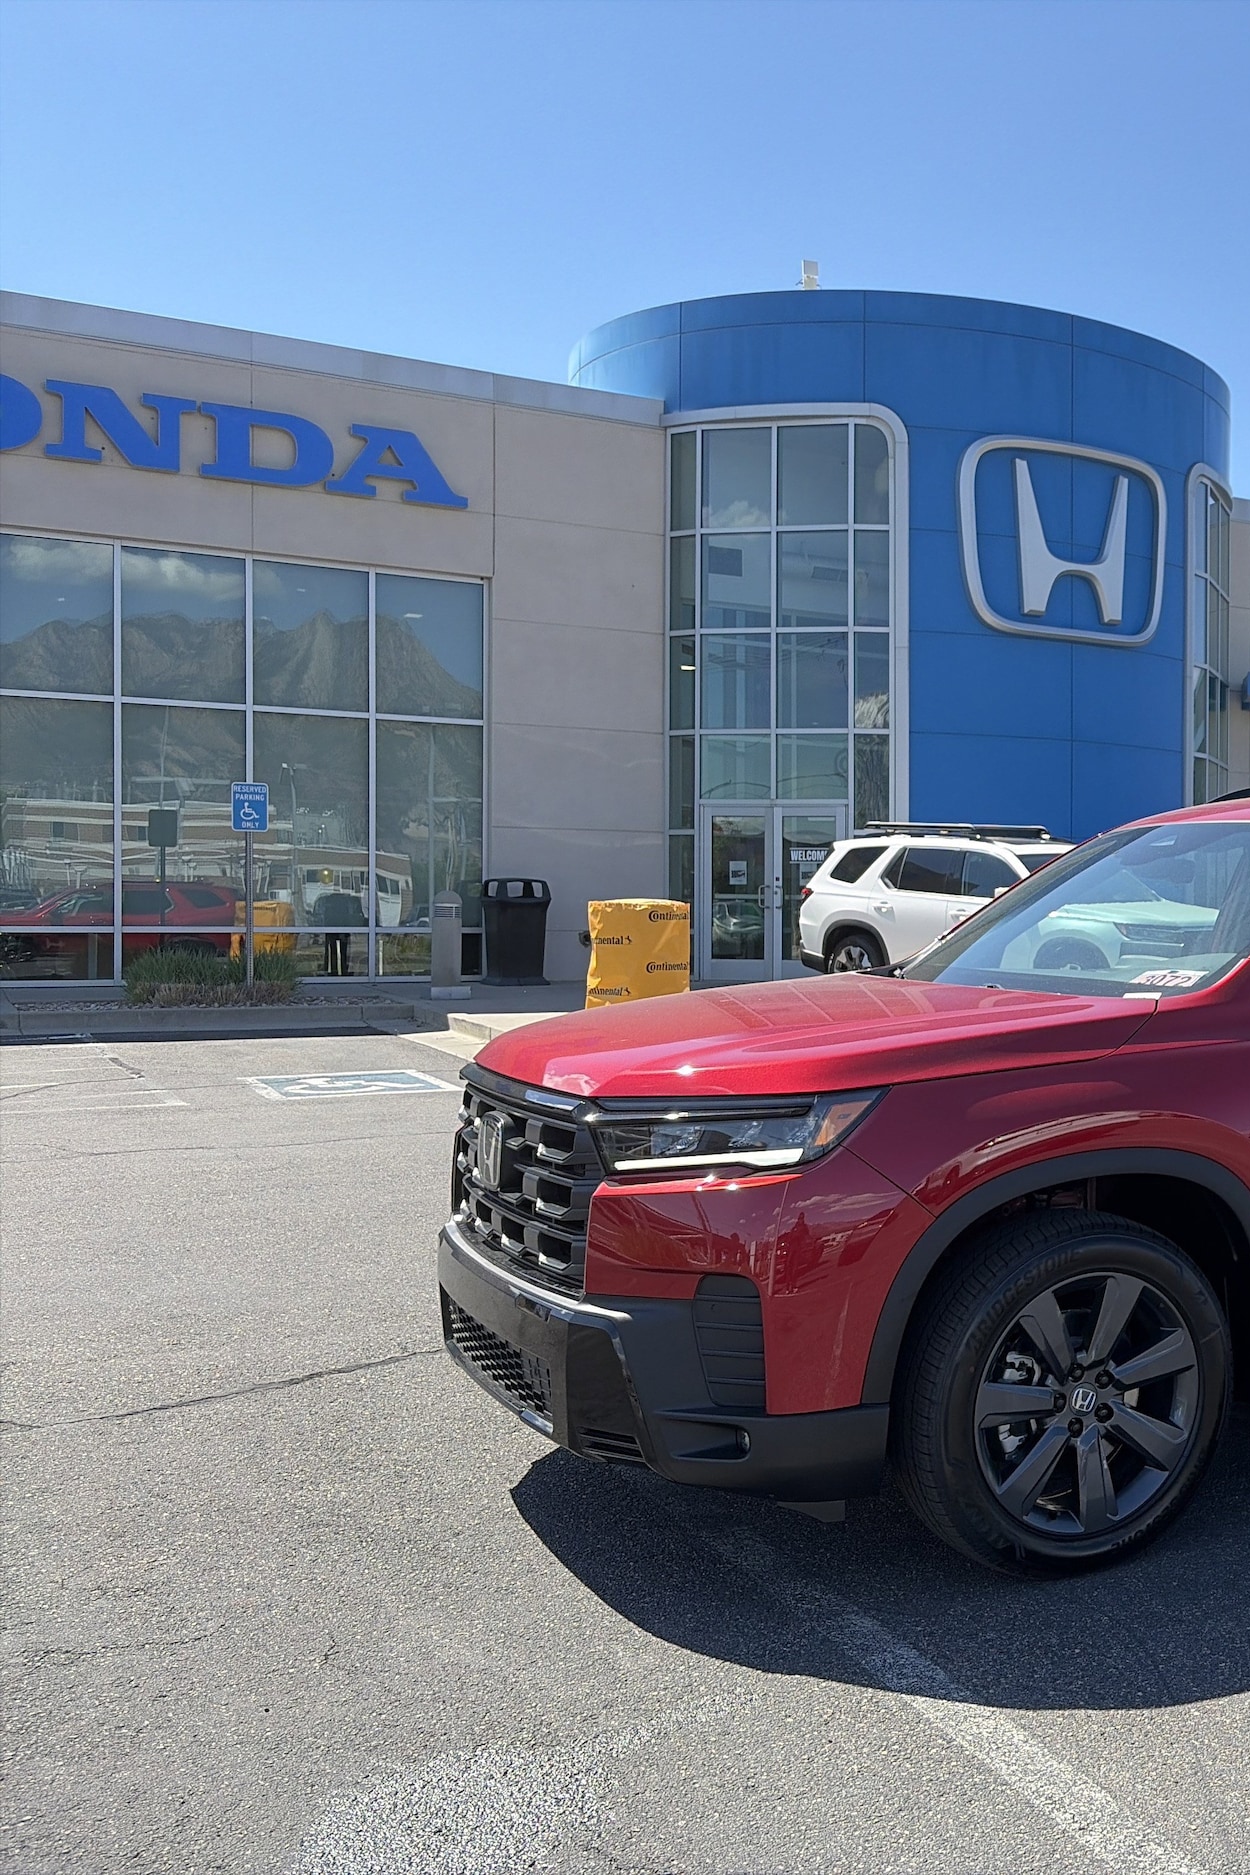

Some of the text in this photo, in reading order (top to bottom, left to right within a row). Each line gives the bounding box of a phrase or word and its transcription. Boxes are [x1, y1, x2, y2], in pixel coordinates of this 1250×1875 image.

[233, 784, 267, 793] RESERVED
[235, 793, 265, 801] PARKING
[241, 821, 260, 829] ONLY
[595, 936, 624, 945] nental
[588, 986, 623, 996] ntinental
